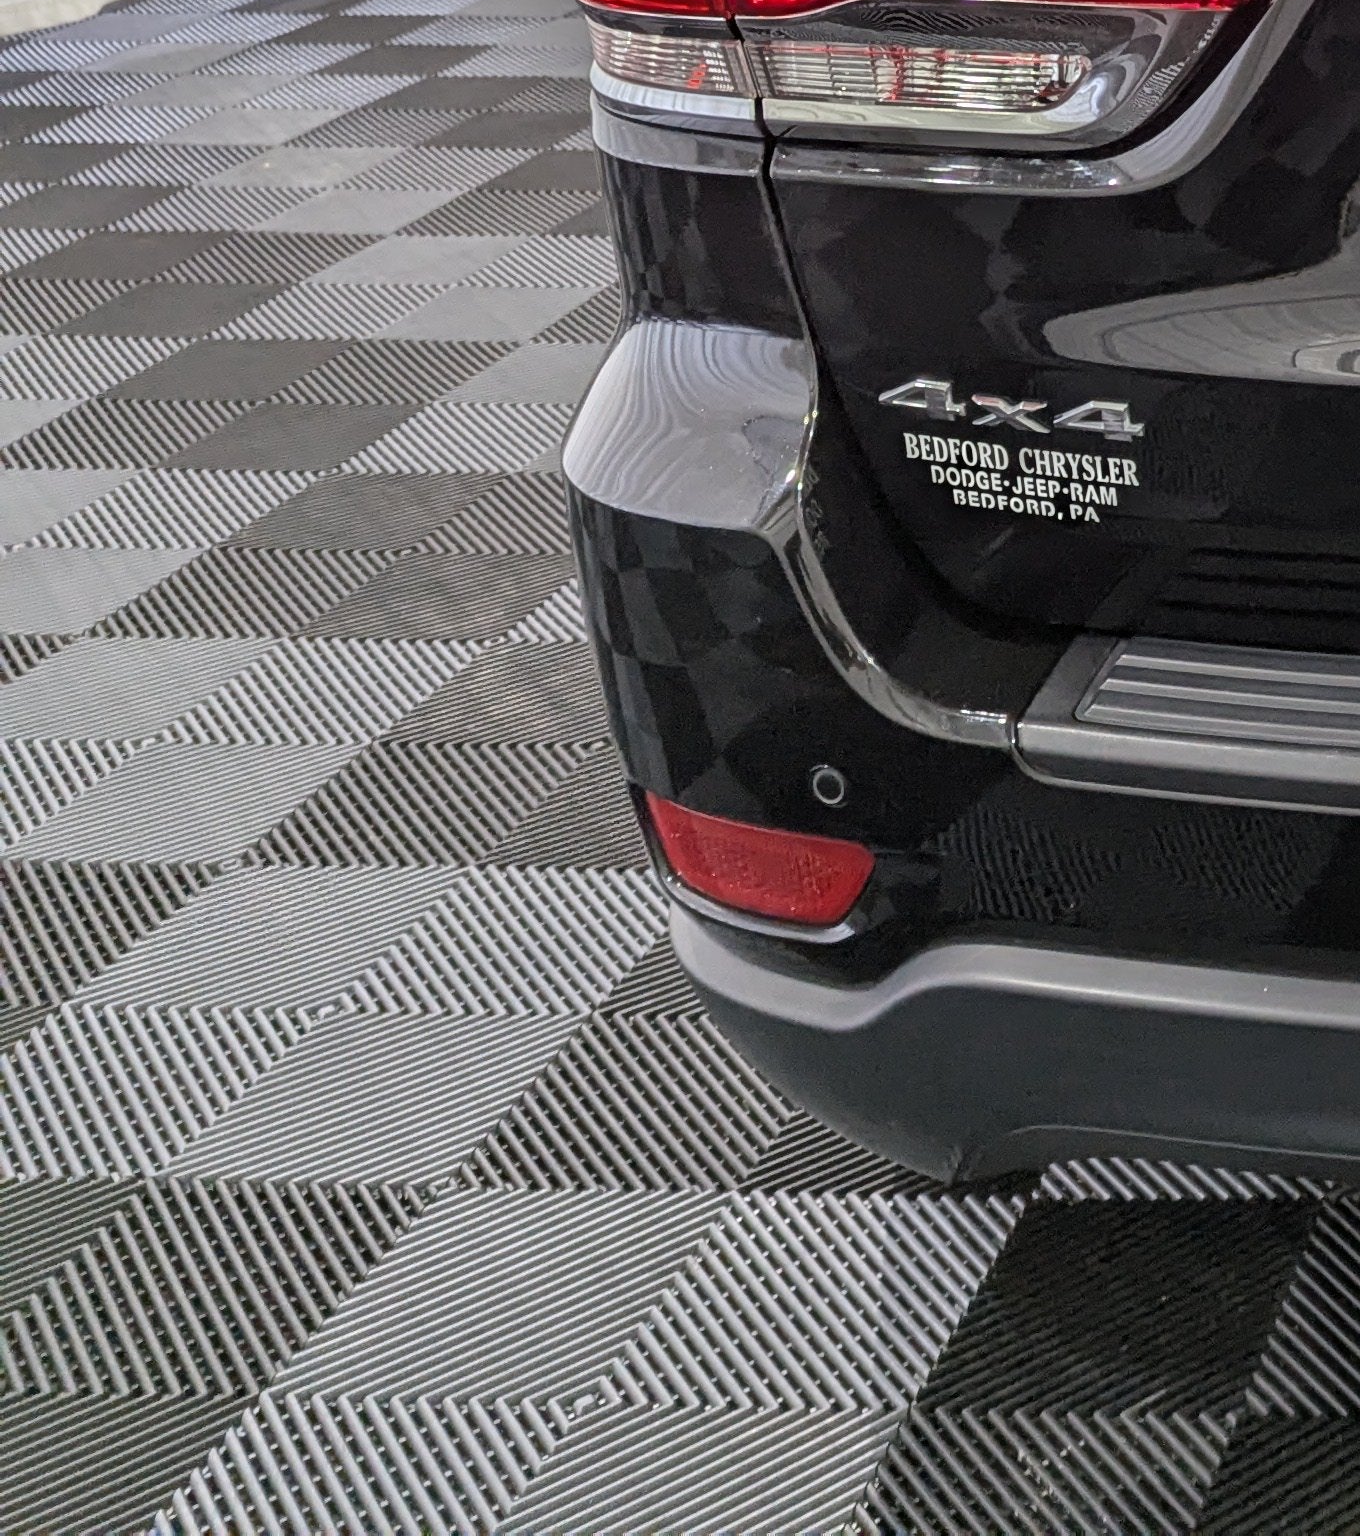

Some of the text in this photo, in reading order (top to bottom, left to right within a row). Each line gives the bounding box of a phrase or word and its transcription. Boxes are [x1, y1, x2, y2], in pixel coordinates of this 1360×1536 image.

[903, 432, 1140, 487] BEDFORD CHRYSLER
[953, 489, 1101, 523] BEDFORD, PA
